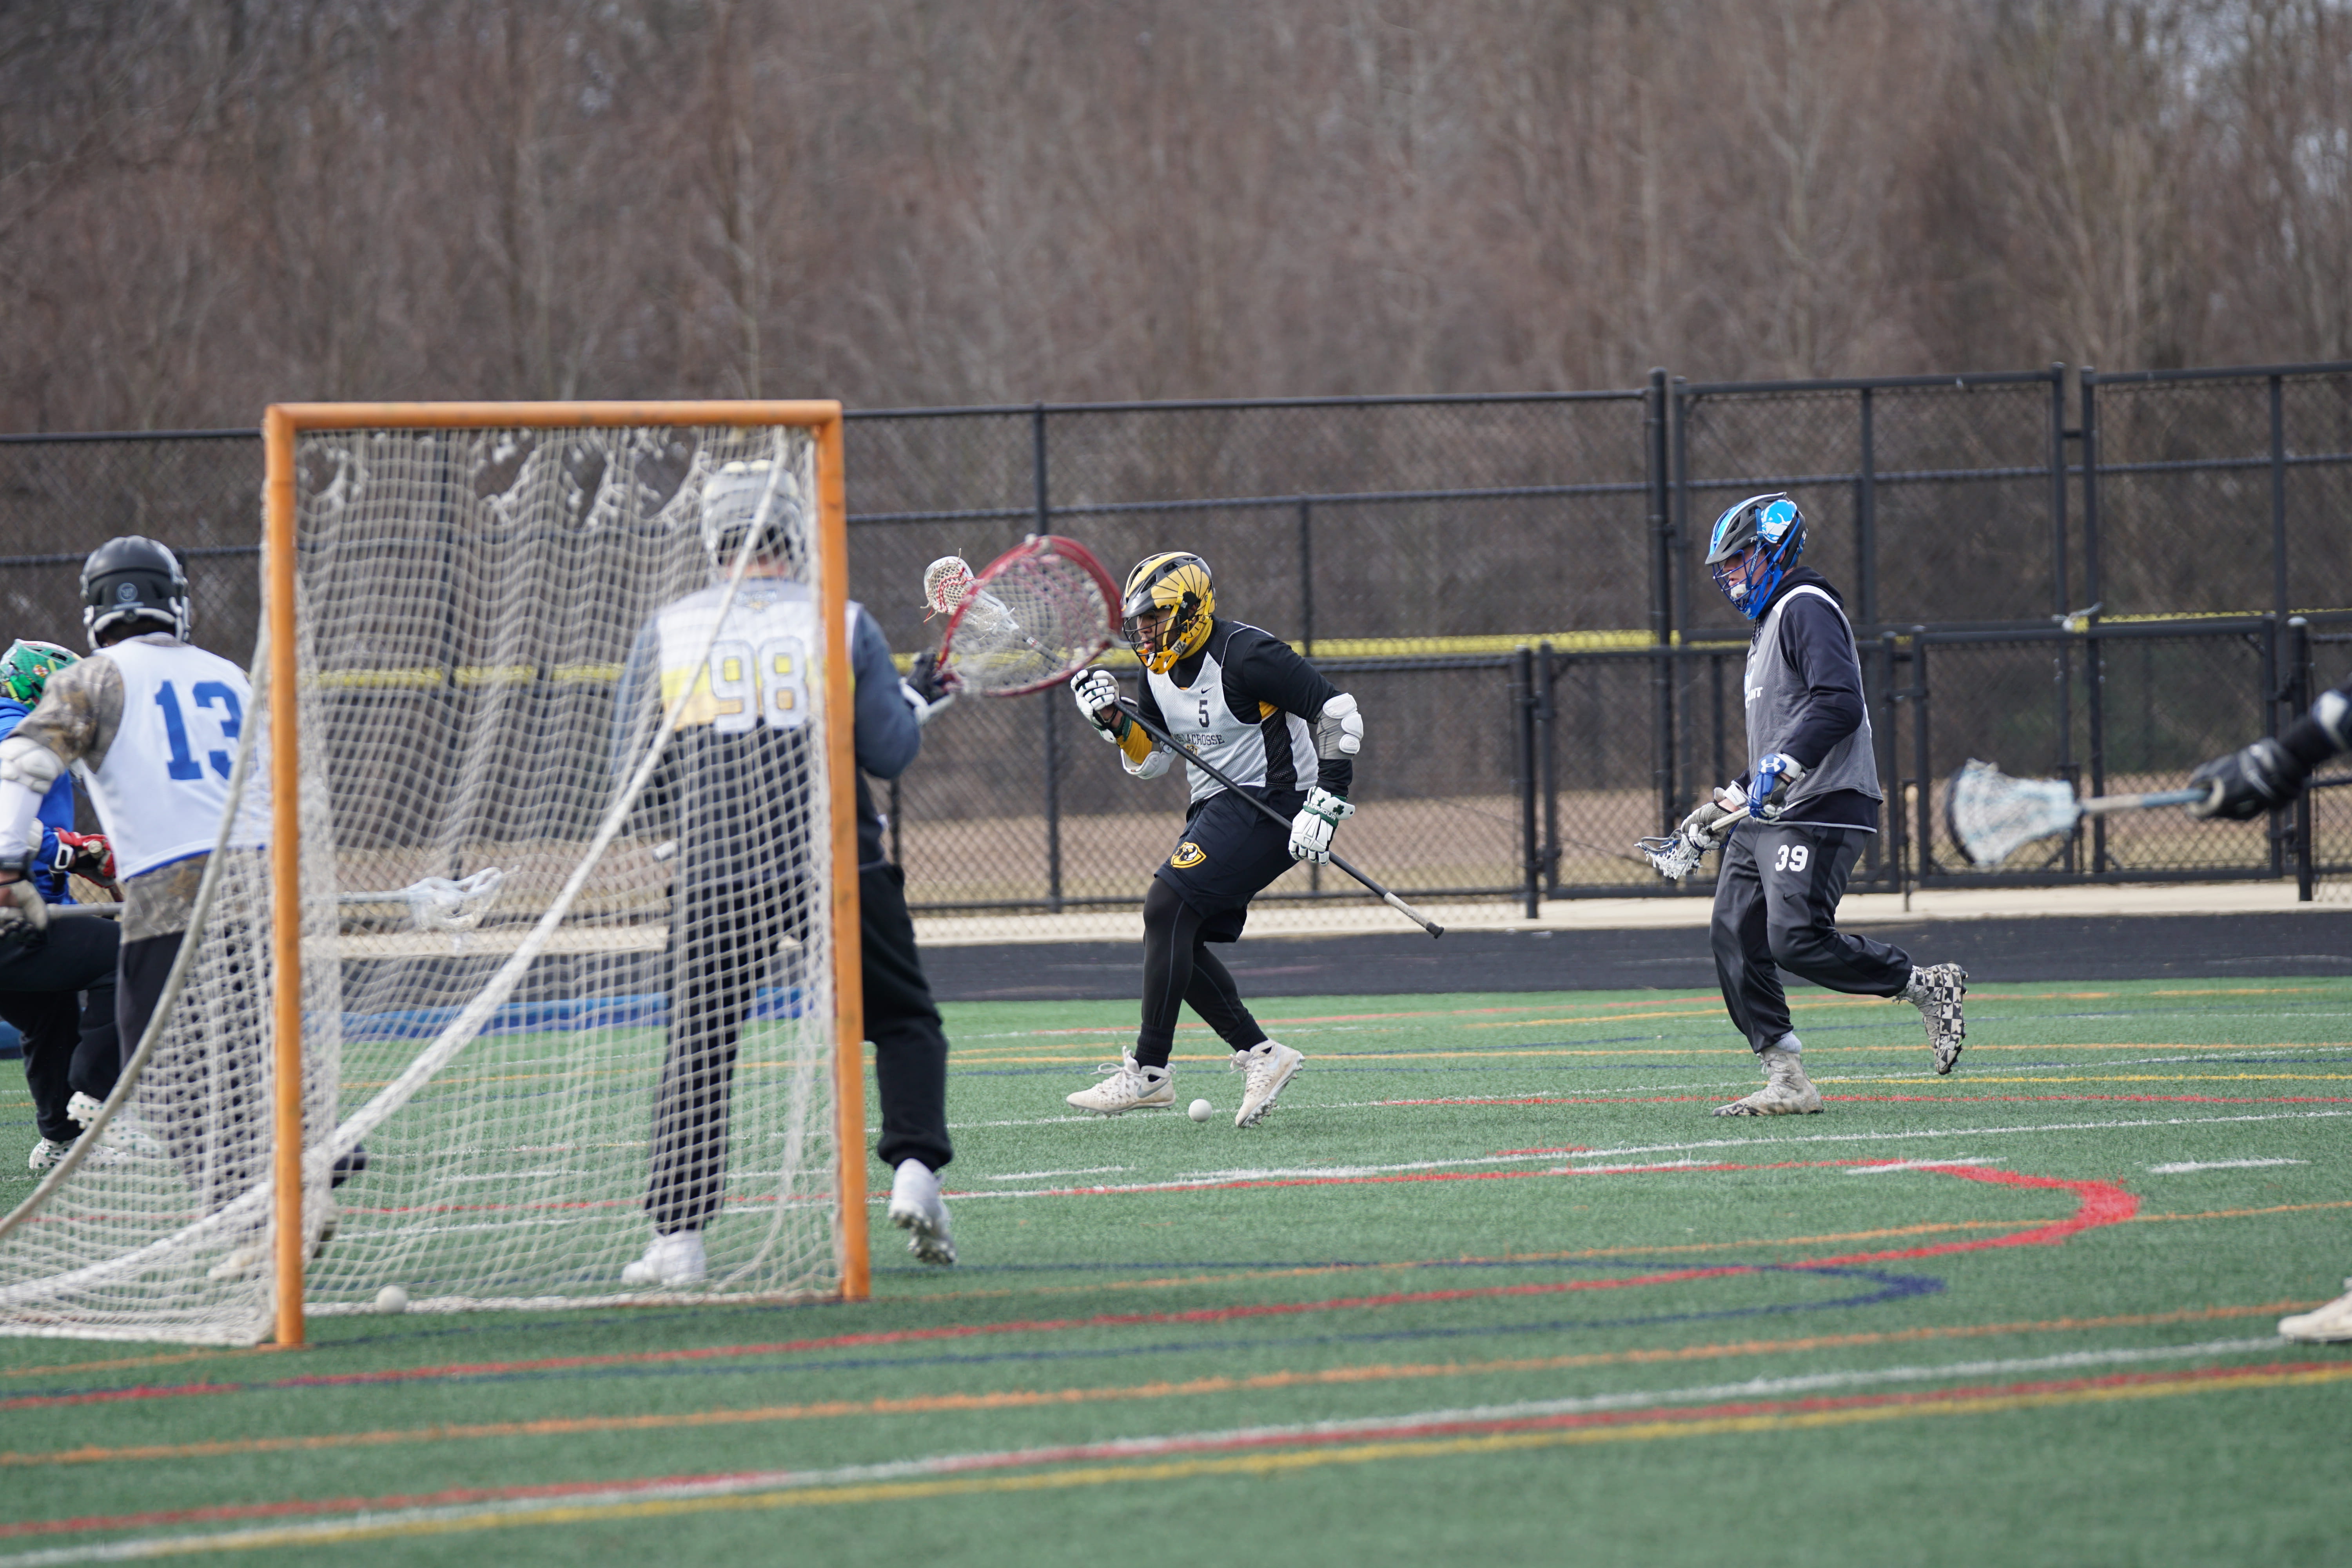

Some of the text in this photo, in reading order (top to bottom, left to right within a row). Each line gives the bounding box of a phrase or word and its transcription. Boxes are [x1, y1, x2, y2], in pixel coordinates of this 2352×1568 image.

[709, 637, 809, 733] 98
[1199, 699, 1210, 728] 5
[155, 681, 260, 780] 13
[1181, 733, 1225, 745] LACROSSE
[1308, 803, 1336, 821] ARMOUR
[1775, 844, 1809, 872] 39
